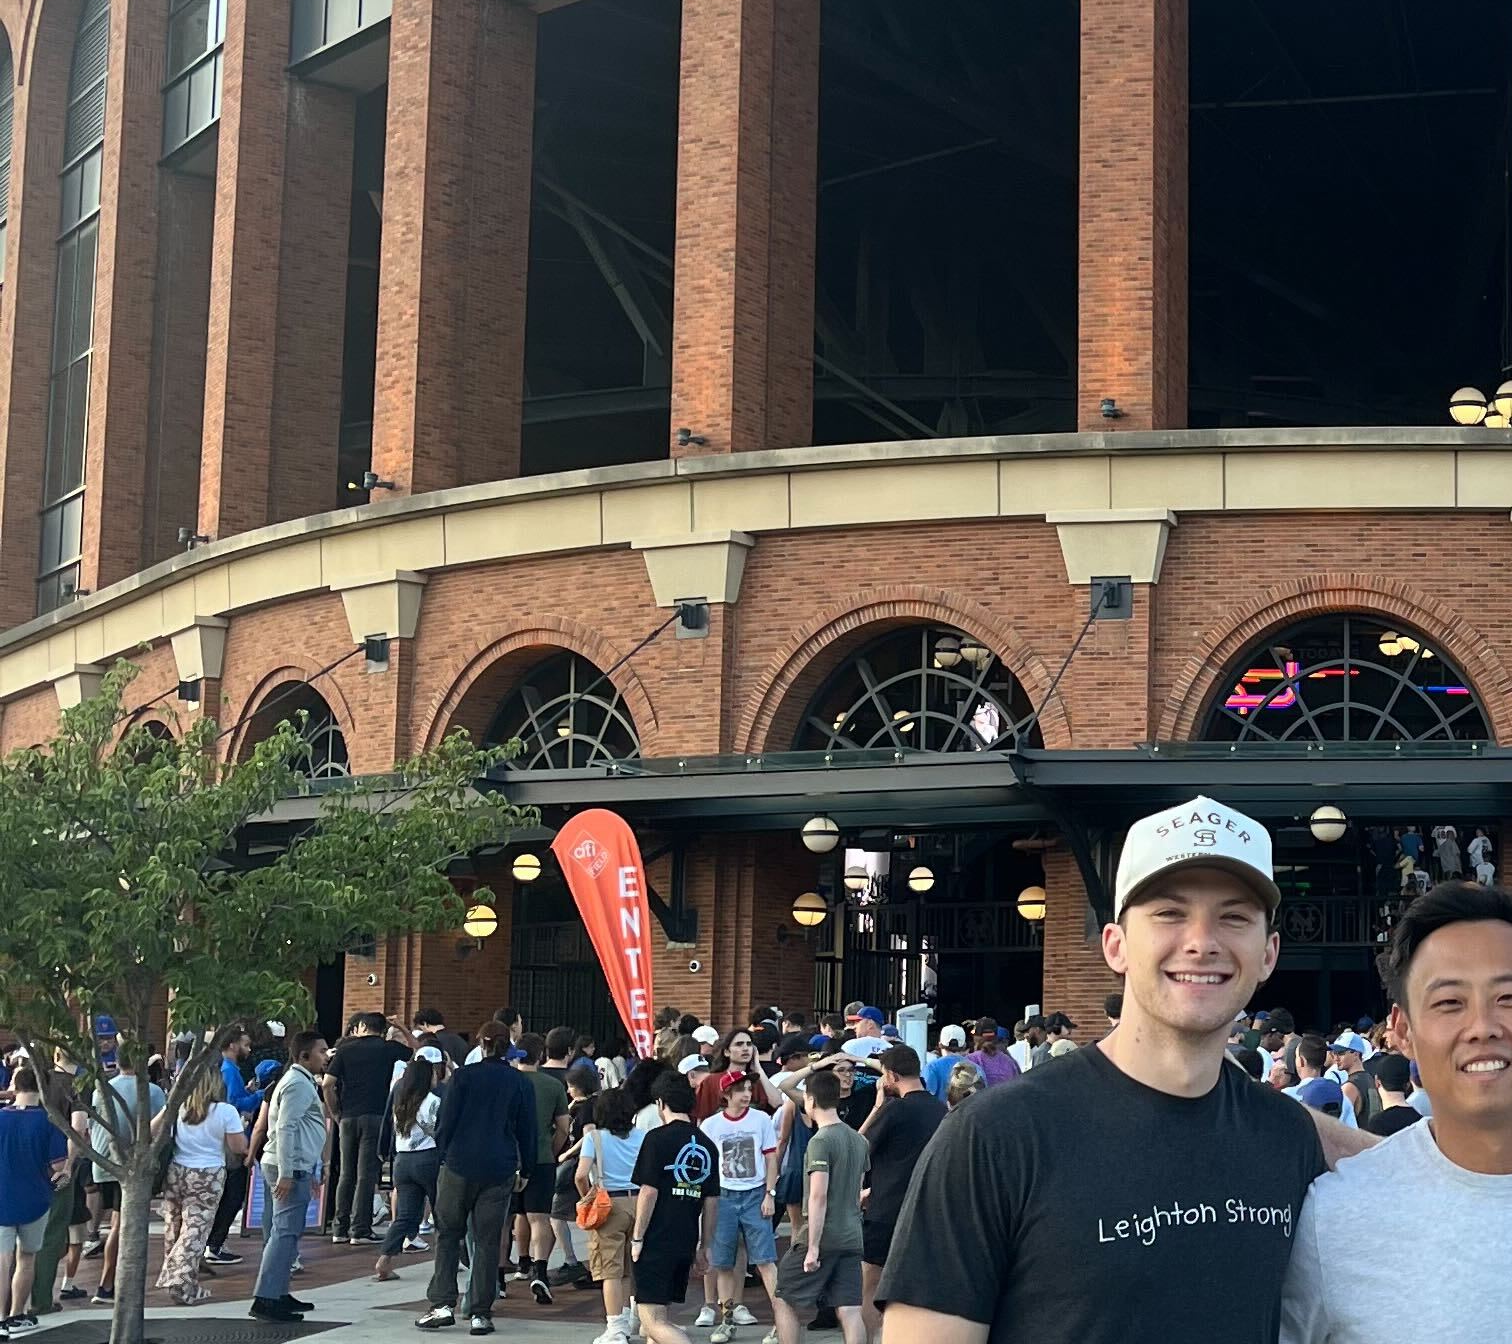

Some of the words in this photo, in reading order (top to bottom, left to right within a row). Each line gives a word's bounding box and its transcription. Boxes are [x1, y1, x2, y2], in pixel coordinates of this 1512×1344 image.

[1156, 812, 1251, 844] SEAGER
[617, 865, 655, 1060] ENTER
[1099, 1201, 1217, 1246] Leighton
[1225, 1199, 1293, 1239] Strong
